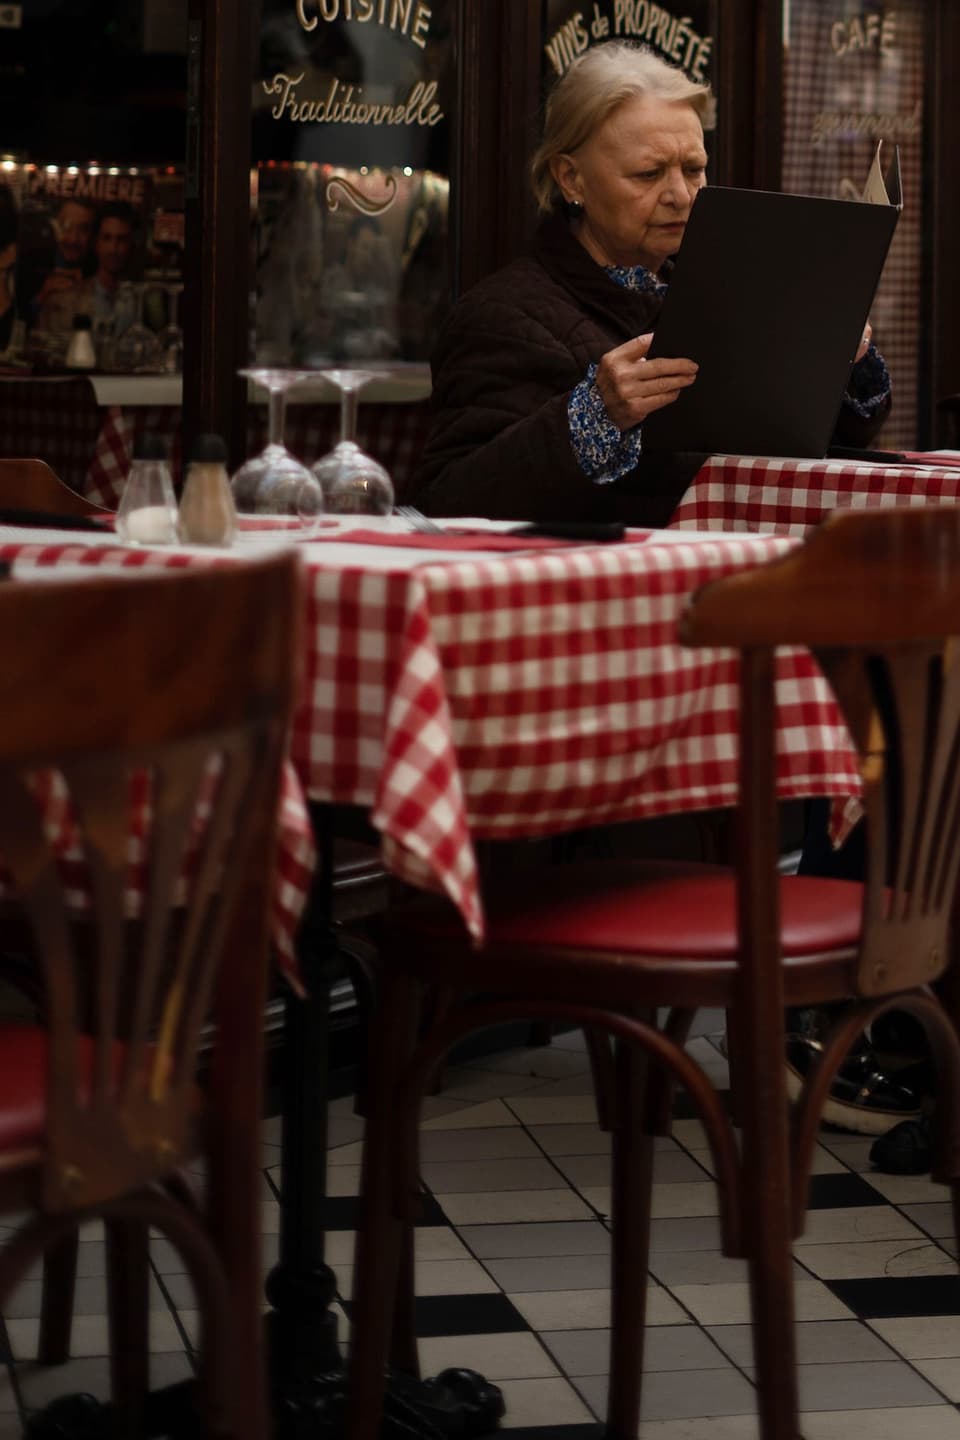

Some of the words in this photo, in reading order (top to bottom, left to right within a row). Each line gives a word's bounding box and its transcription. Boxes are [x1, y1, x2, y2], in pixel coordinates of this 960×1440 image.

[544, 12, 590, 76] VINS
[590, 1, 610, 40] de
[262, 71, 445, 128] Traditionnelle
